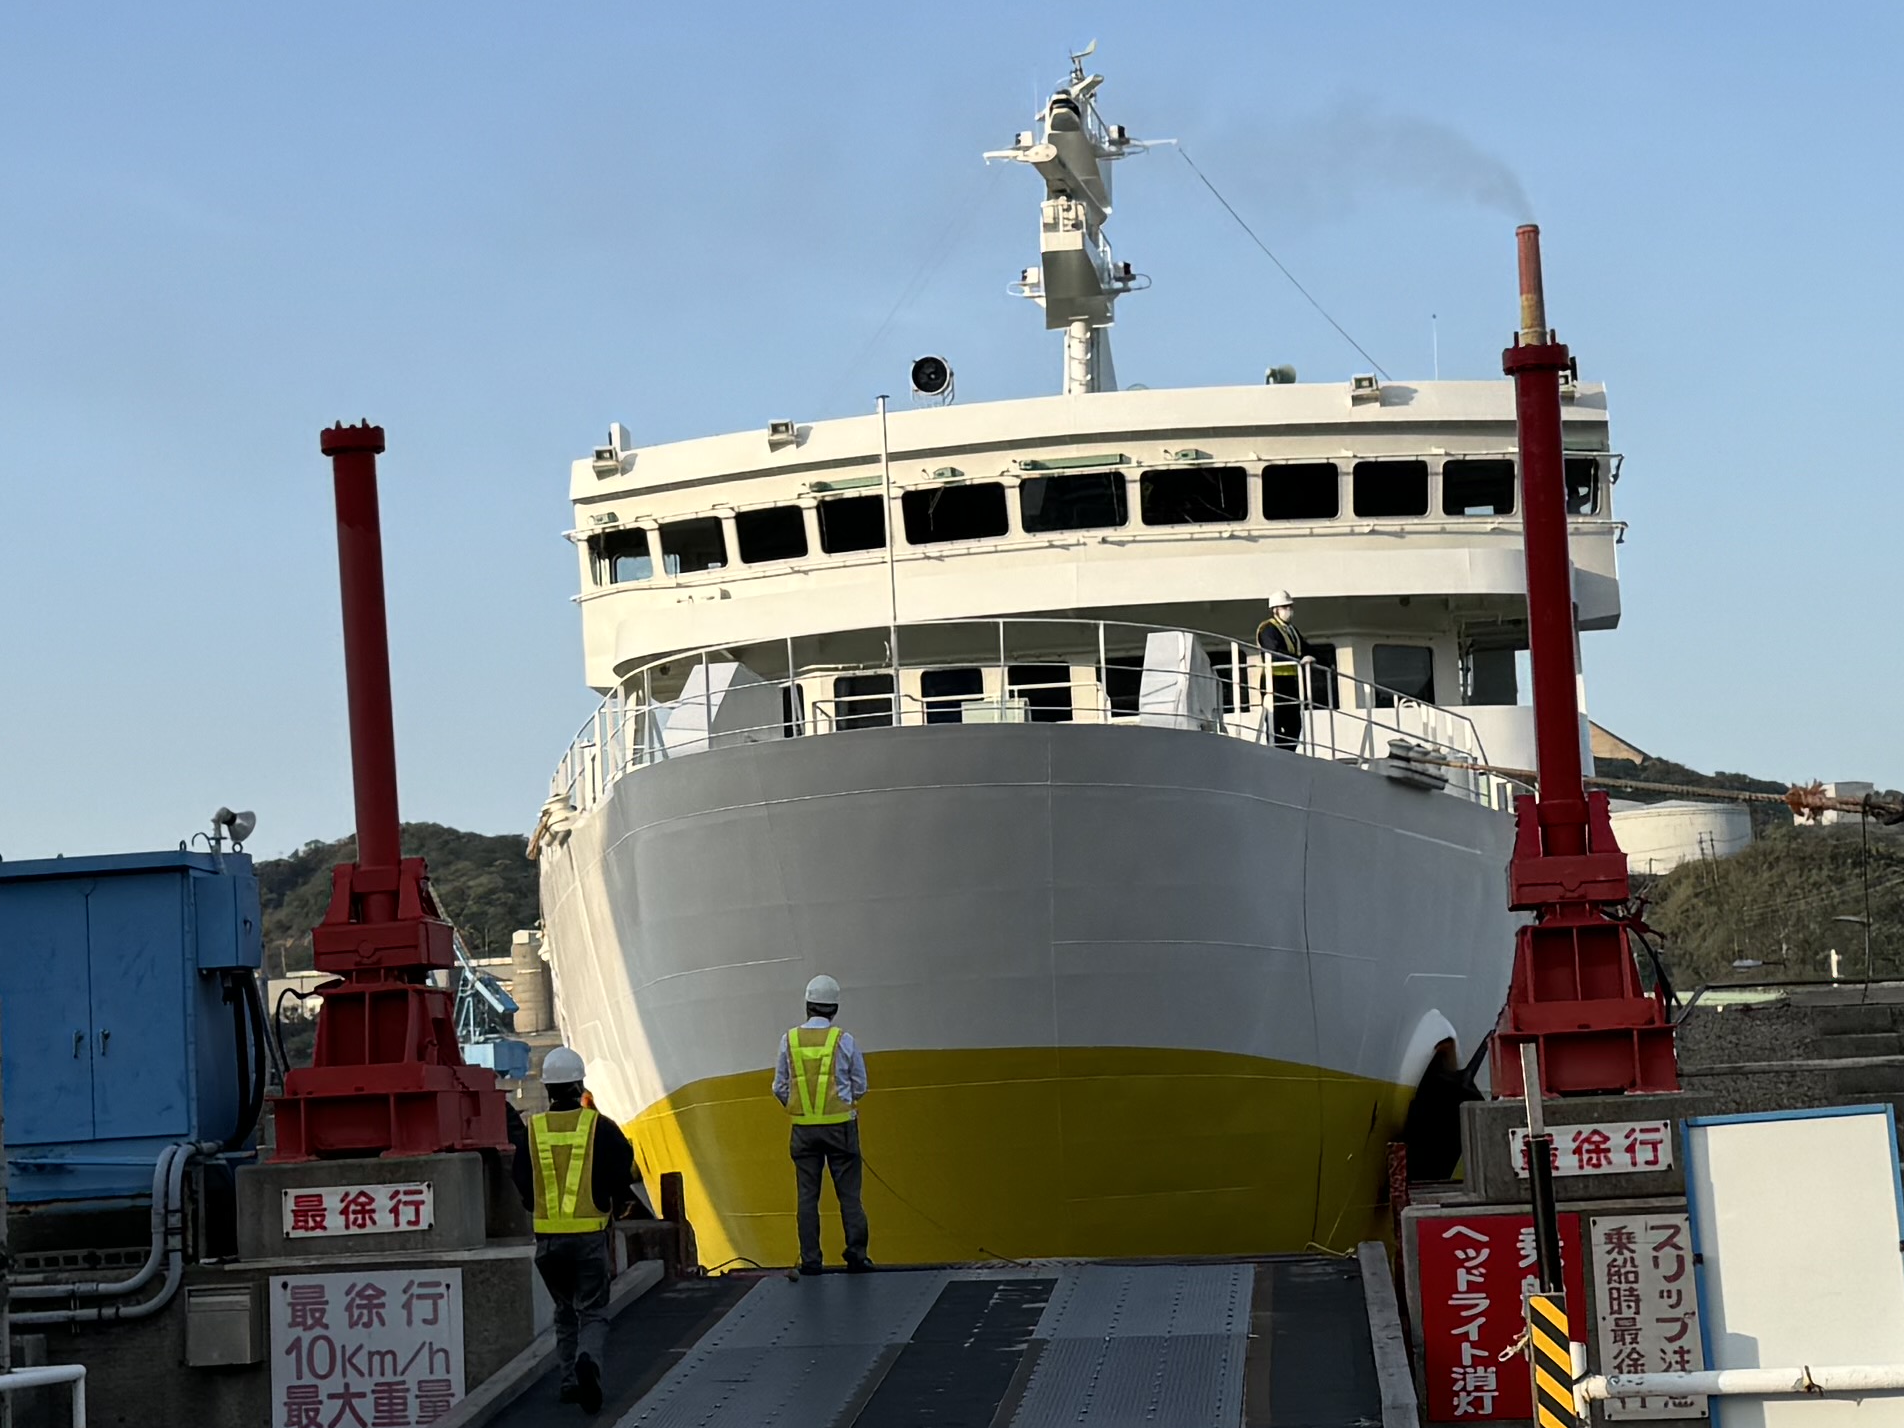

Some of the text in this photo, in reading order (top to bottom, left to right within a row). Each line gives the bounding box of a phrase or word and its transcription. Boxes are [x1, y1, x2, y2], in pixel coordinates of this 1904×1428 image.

[290, 1188, 426, 1232] 最徐行
[287, 1279, 445, 1332] 最徐行
[1442, 1225, 1499, 1416] ヘッドライト消灯
